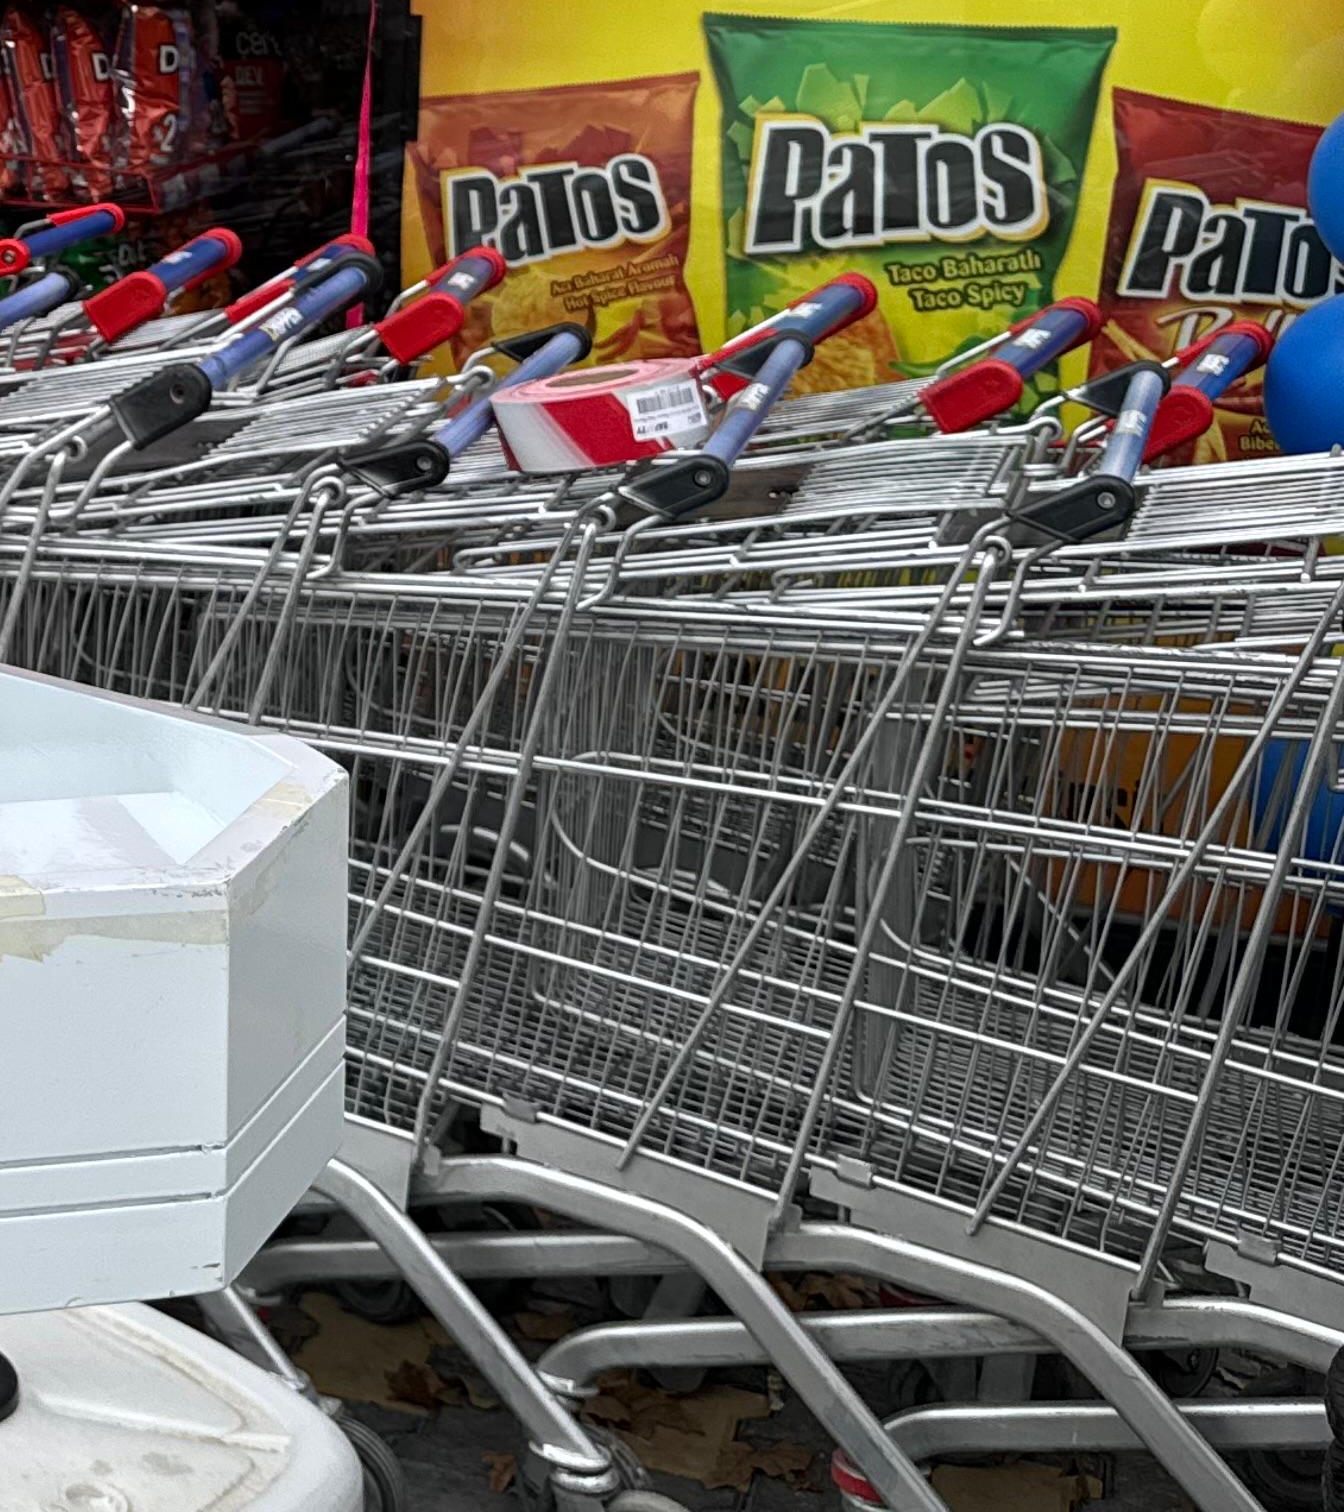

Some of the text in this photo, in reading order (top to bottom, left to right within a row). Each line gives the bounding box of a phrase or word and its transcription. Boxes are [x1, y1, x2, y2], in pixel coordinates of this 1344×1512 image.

[887, 249, 1042, 284] Taco Baharatlı
[911, 282, 1026, 309] Taco Spicy
